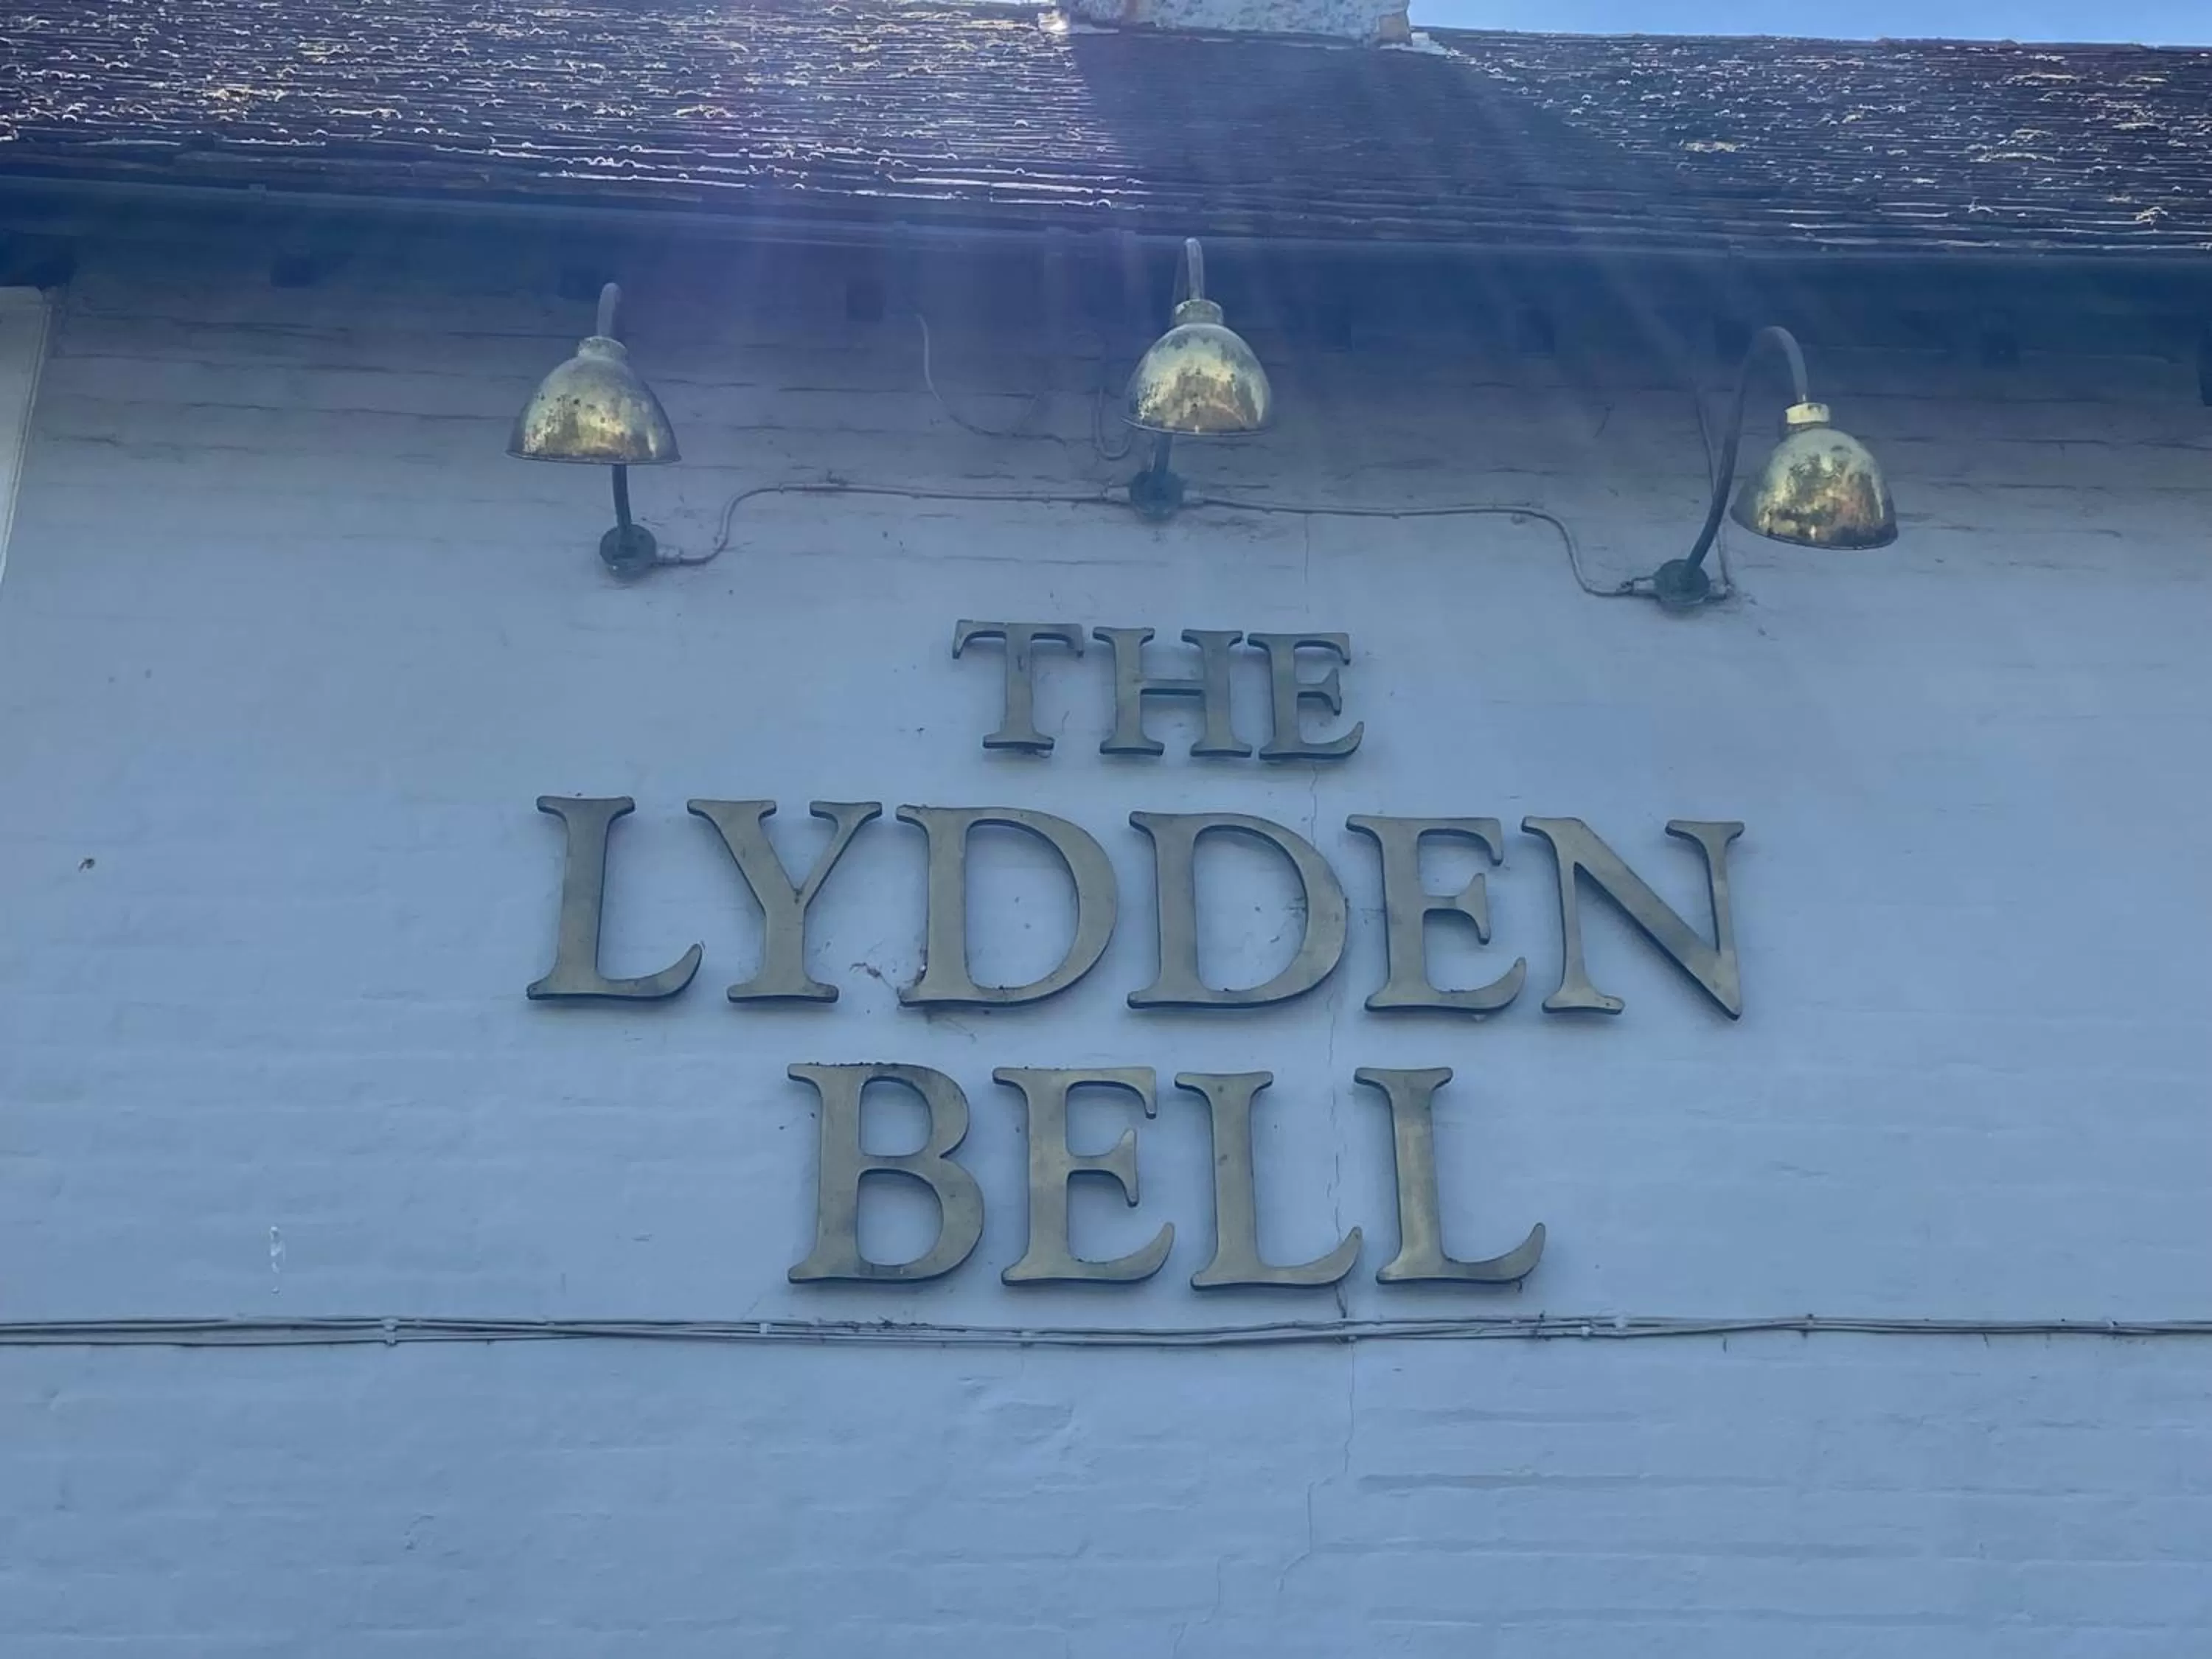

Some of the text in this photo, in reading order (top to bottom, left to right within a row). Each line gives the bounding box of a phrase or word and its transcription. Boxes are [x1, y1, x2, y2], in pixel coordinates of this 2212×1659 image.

[952, 619, 1364, 761] THE
[528, 796, 1745, 1019] LYDDEN
[787, 1063, 1545, 1289] BELL
